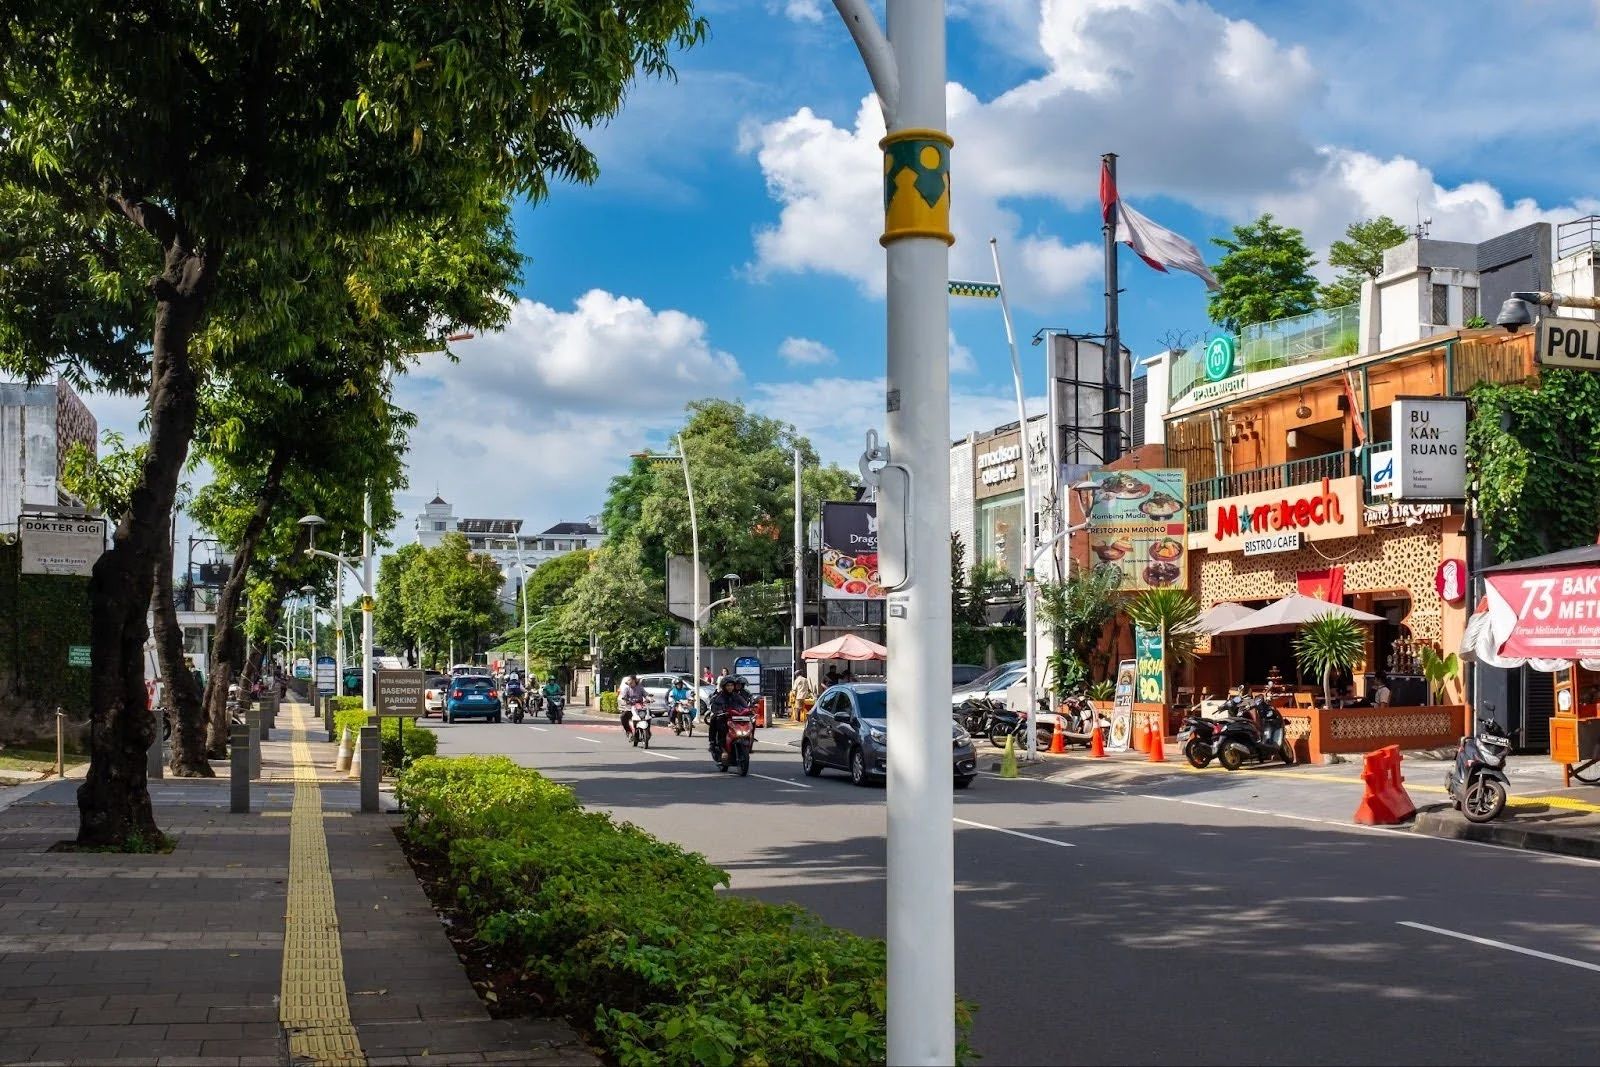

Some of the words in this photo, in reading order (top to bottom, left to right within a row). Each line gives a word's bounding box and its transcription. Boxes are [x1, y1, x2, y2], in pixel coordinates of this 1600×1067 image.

[1410, 410, 1430, 423] BU
[1410, 427, 1440, 440] KAN
[1410, 444, 1458, 456] RUANG
[1125, 511, 1147, 519] Muda
[26, 522, 72, 531] DOKTER
[77, 525, 99, 533] GIGI
[1131, 526, 1166, 534] MAROKO
[1245, 538, 1272, 552] BISTRO
[1277, 535, 1297, 548] CAFE
[1519, 578, 1556, 620] 73
[381, 687, 420, 695] BASEMENT
